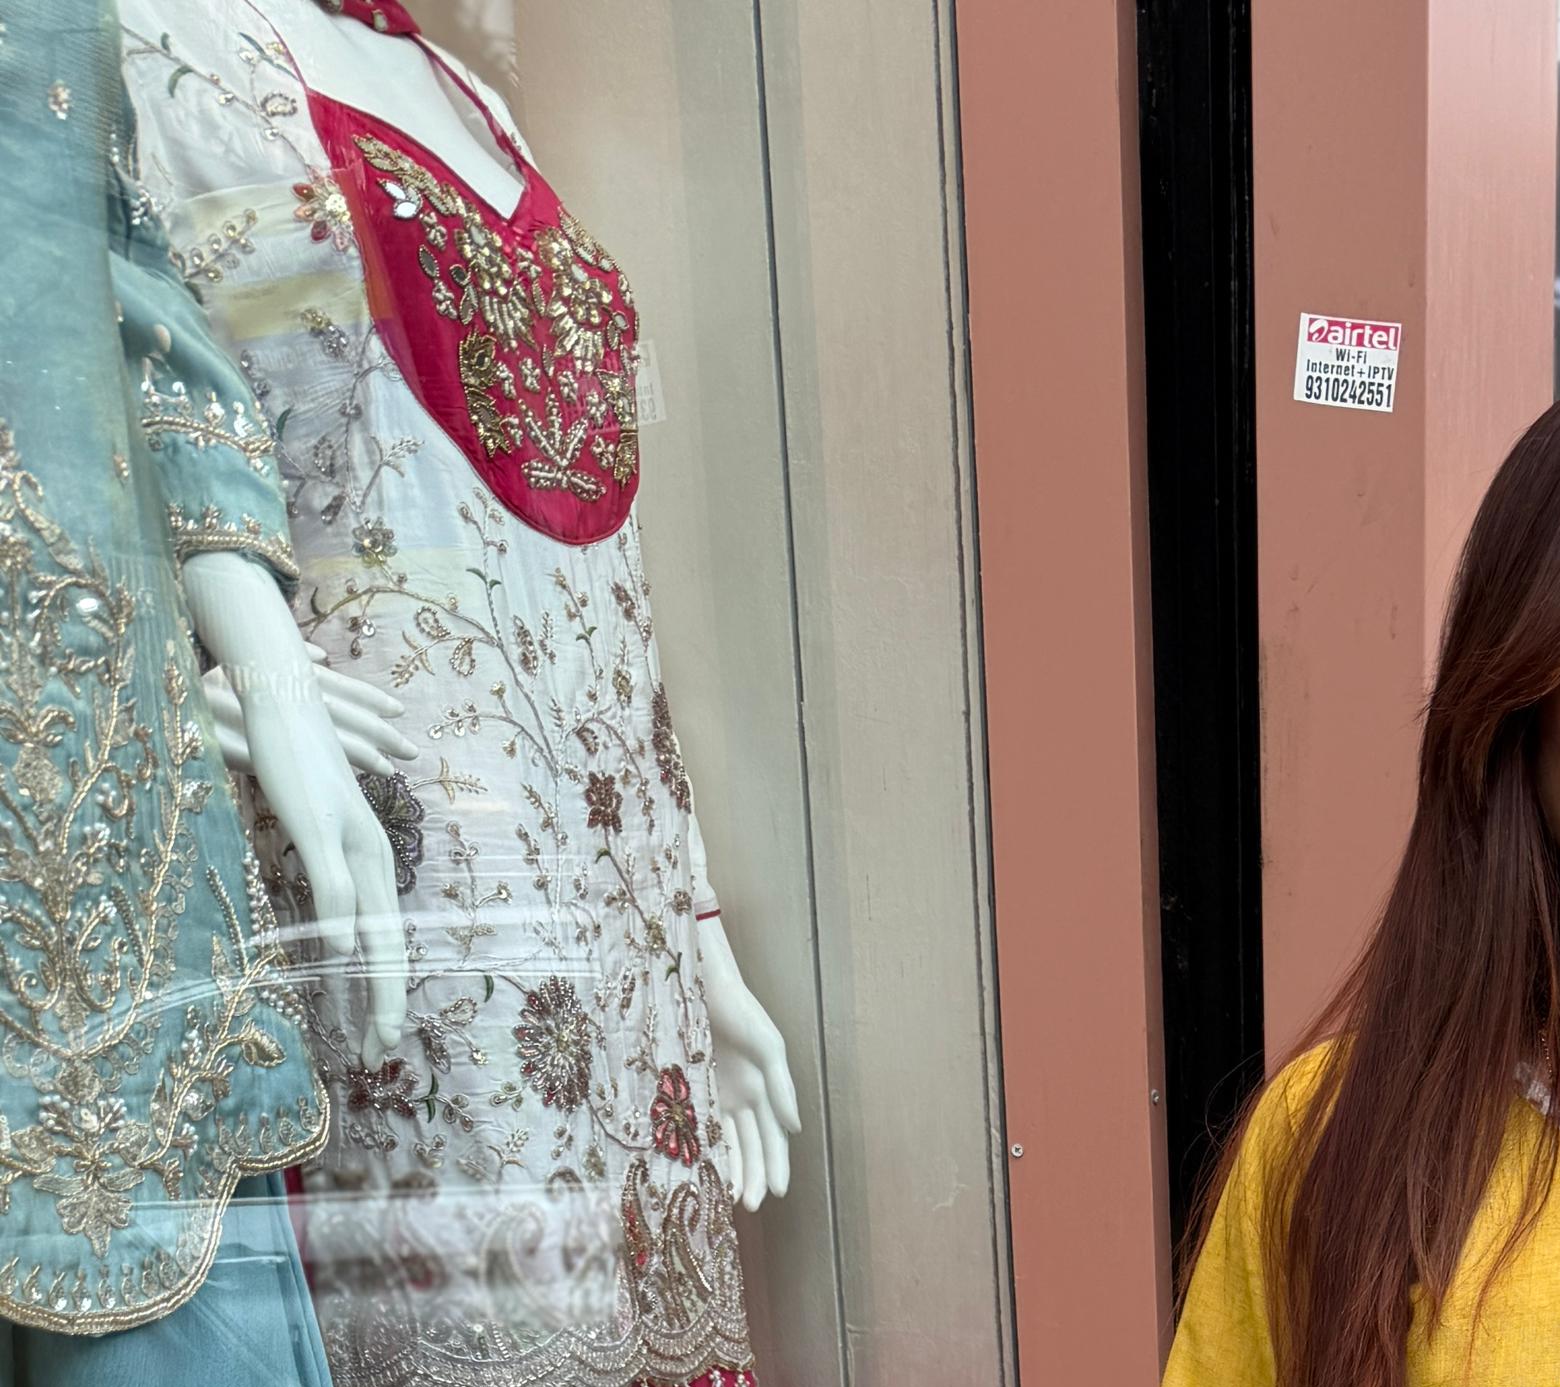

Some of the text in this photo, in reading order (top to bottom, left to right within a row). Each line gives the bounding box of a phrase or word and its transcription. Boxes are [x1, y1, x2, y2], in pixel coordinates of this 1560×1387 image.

[1327, 321, 1397, 350] airtel
[1335, 348, 1368, 365] Wi-Fi
[1305, 375, 1393, 408] 9310242551
